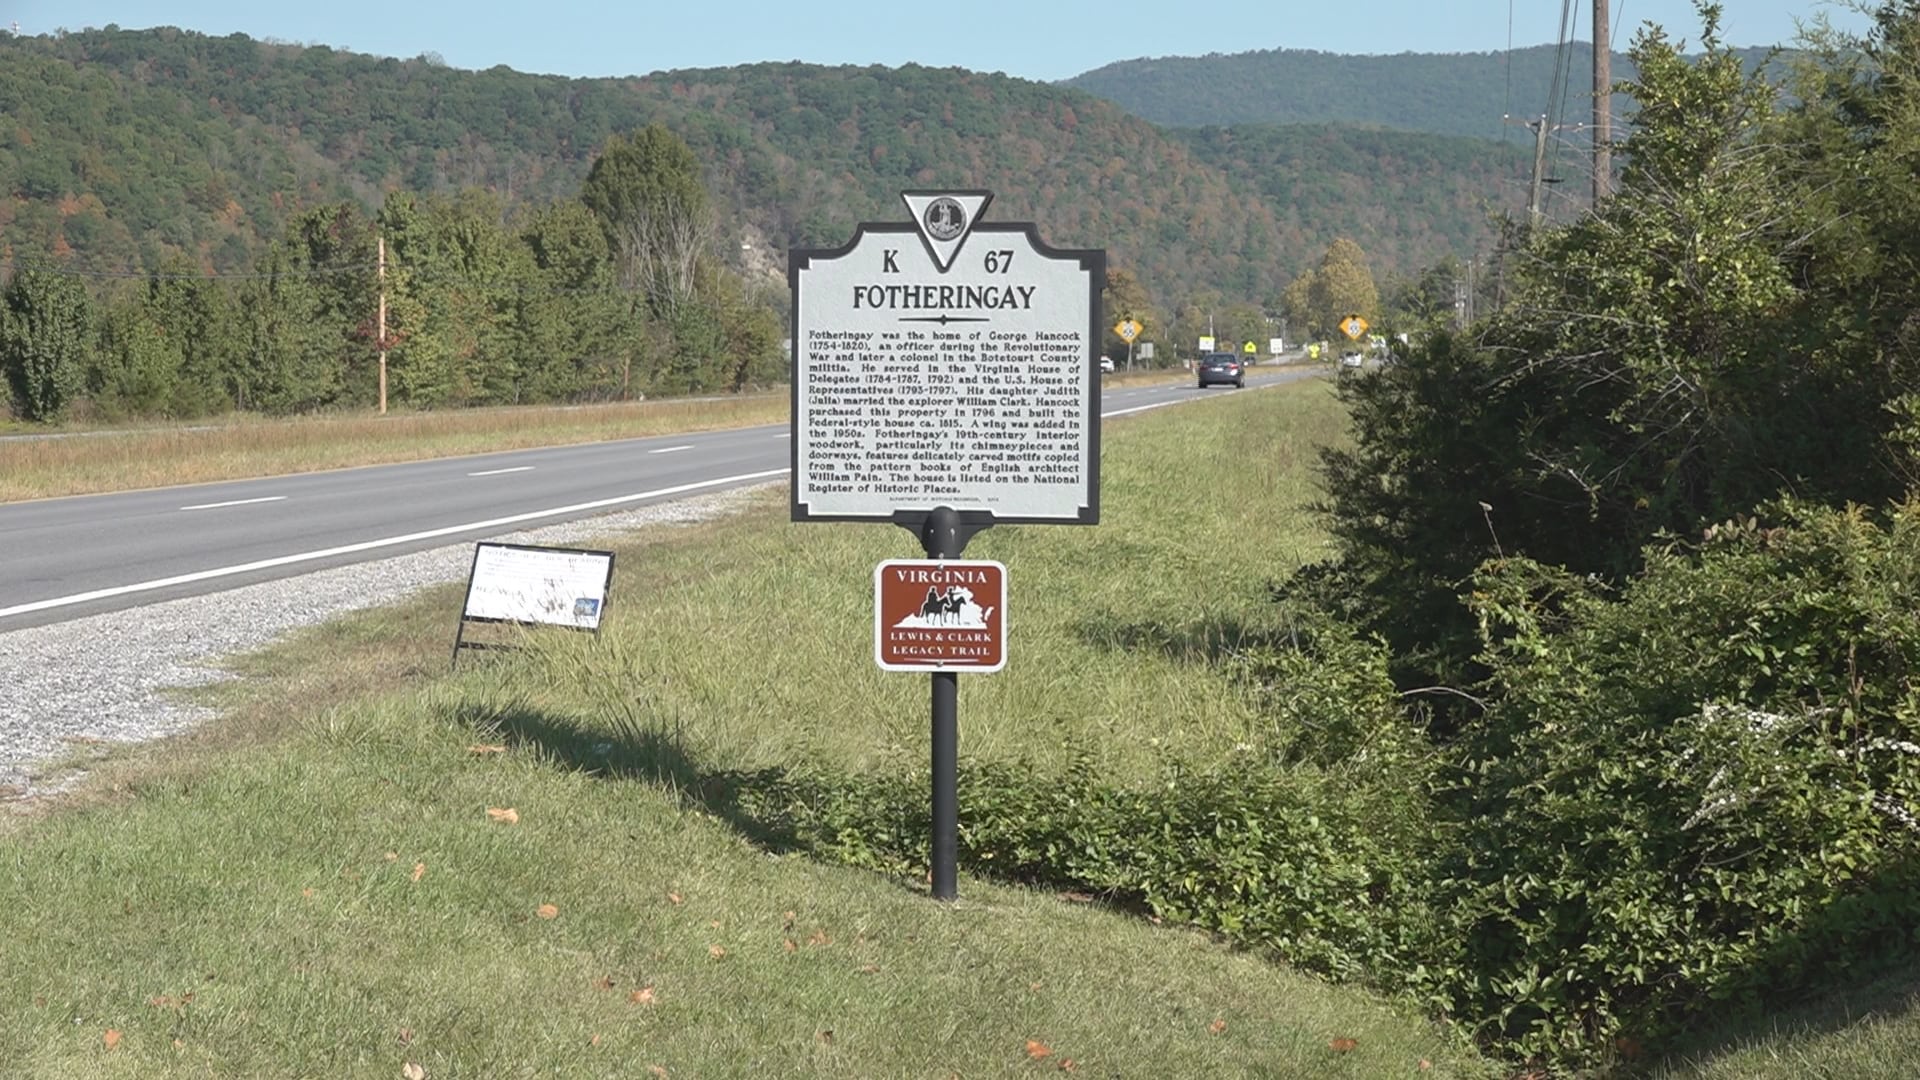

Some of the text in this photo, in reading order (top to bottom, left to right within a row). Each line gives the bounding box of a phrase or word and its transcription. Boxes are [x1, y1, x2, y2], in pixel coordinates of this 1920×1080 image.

[883, 250, 1014, 274] K 67
[853, 285, 1036, 309] FOTHERINGAY
[808, 330, 874, 342] Fotheringay
[907, 330, 926, 340] the
[932, 330, 962, 341] home
[968, 331, 982, 341] of
[988, 330, 1028, 343] George
[1035, 331, 1081, 341] Hancock
[895, 341, 935, 351] officer
[939, 341, 975, 354] during
[980, 342, 999, 352] the
[1003, 342, 1081, 355] Revolutionary
[808, 352, 830, 362] War
[834, 352, 855, 362] and
[858, 352, 885, 362] later
[899, 352, 939, 362] colonel
[943, 353, 955, 362] in
[958, 353, 977, 362] the
[980, 352, 1035, 363] Botetourt
[1039, 352, 1081, 365] County
[808, 362, 1081, 376] militia. He served in the Virginia House of
[808, 373, 860, 386] Delegates
[958, 374, 978, 384] and
[981, 375, 1001, 385] the
[1004, 374, 1026, 385] U.S.
[1030, 375, 1064, 385] House
[1067, 375, 1080, 385] of
[808, 385, 894, 397] Representatives
[966, 386, 985, 396] His
[988, 386, 1039, 398] daughter
[1043, 386, 1080, 396] Judith
[808, 395, 1080, 408] (Julia) married the explorer William Clark. Hancock
[808, 407, 862, 419] purchased
[869, 407, 891, 417] this
[897, 408, 948, 419] property
[954, 408, 966, 417] in
[1001, 408, 1021, 418] and
[1028, 408, 1055, 418] built
[1062, 408, 1080, 418] the
[808, 417, 881, 429] Federal-style
[884, 418, 915, 428] house
[919, 420, 935, 428] ca.
[970, 419, 980, 429] A
[982, 419, 1007, 431] wing
[1032, 419, 1066, 429] added
[1068, 420, 1080, 429] in
[808, 428, 827, 438] the
[875, 428, 949, 441] Fotheringay's
[1036, 430, 1080, 440] interior
[808, 439, 1080, 453] woodwork, particularly its chimneypieces and
[808, 450, 1080, 464] doorways, features delicately carved motifs copied
[808, 461, 1080, 474] from the pattern books of English architect
[808, 472, 1080, 484] William Pain. The house is listed on the National
[808, 482, 961, 494] Register of Historic Places.
[897, 570, 987, 583] VIRGINIA
[890, 632, 992, 642] LEWIS & CLARK
[893, 646, 990, 655] LEGACY TRAIL
